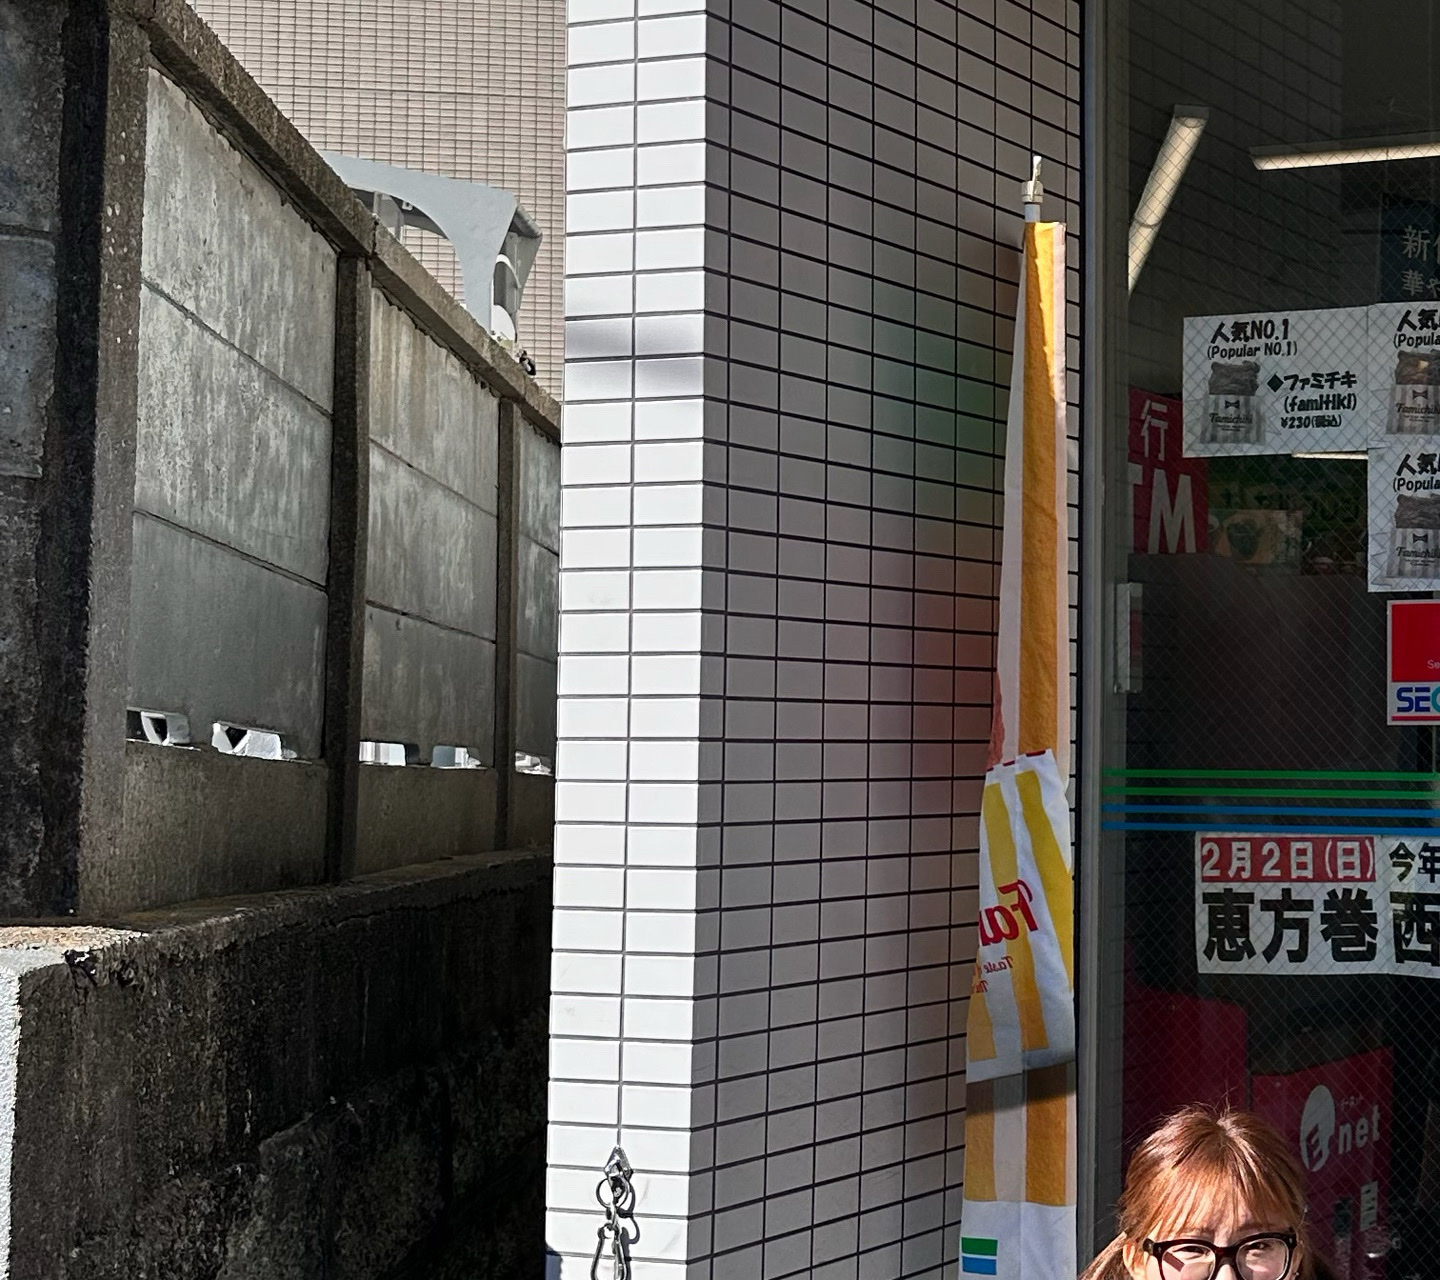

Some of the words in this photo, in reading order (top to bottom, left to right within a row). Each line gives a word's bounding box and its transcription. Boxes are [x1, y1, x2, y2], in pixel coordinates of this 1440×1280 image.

[1210, 318, 1289, 344] 人気NO.1
[1207, 344, 1261, 360] (Popular
[1264, 341, 1298, 357] NO.1)
[1283, 371, 1357, 391] ファミチキ
[1201, 838, 1376, 882] 2月2日(日)
[1201, 887, 1380, 965] 恵方巻
